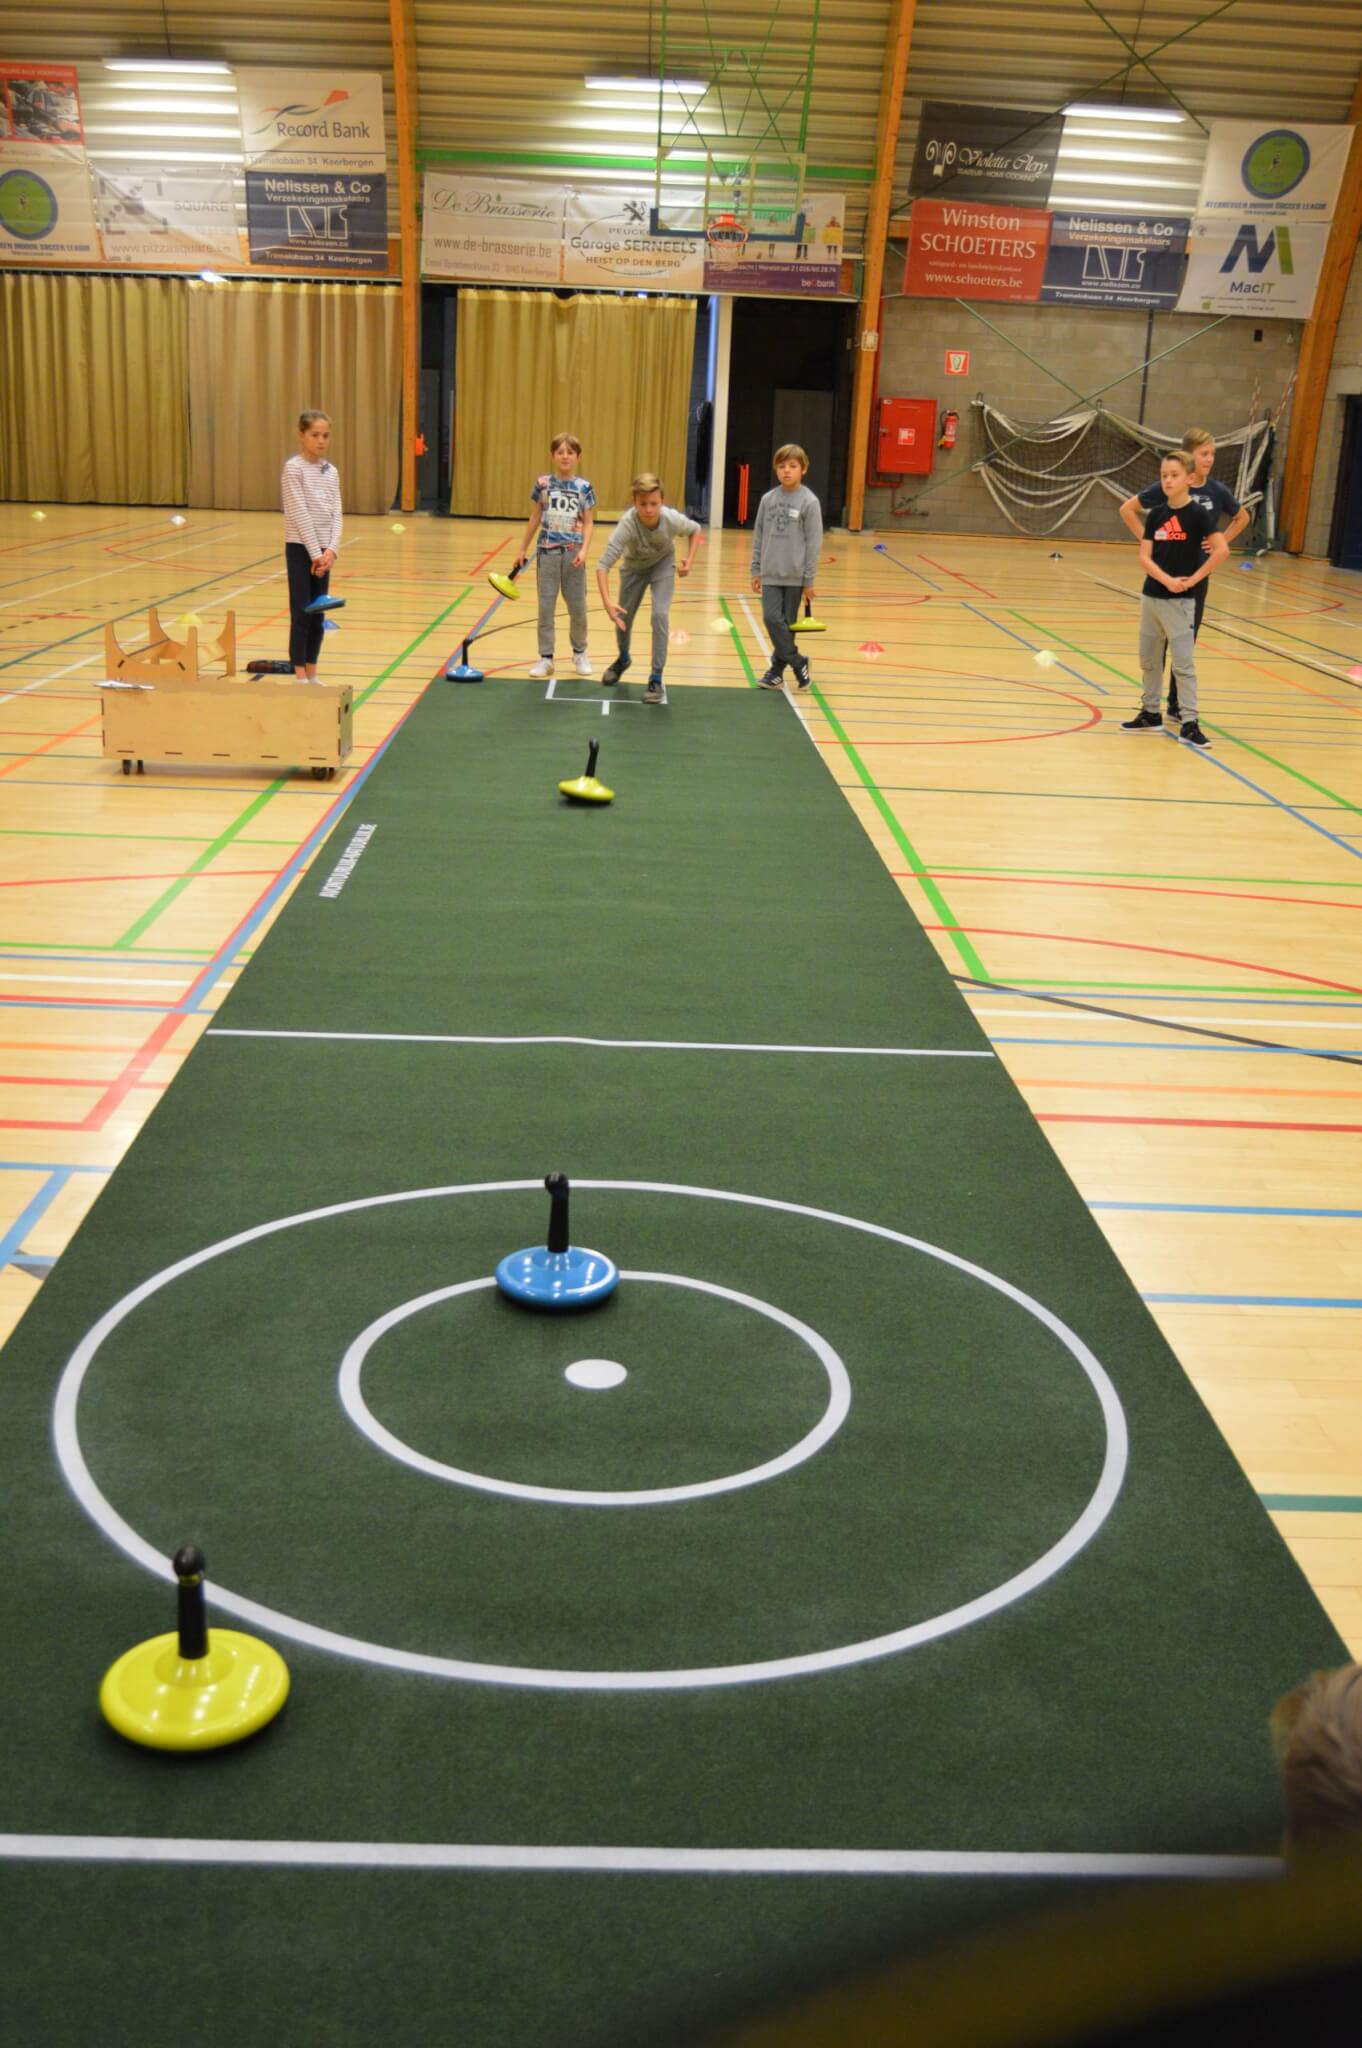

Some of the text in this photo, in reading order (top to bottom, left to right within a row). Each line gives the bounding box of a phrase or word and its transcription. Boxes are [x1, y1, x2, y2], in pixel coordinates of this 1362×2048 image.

[277, 120, 370, 138] Record Bank
[959, 147, 1011, 168] Violetta
[264, 178, 372, 194] Nelissen & Co
[174, 200, 229, 212] SQUARE
[432, 187, 555, 217] De Brasserie
[942, 207, 1020, 231] Winston
[1068, 216, 1174, 236] Nelissen & Co
[608, 227, 651, 236] PEUGE
[434, 234, 552, 258] www.de-brasserie.be
[570, 236, 697, 254] Garage SERNEELS
[920, 232, 1036, 259] SCHOETERS
[585, 256, 613, 265] HEIST
[632, 258, 652, 266] DEN
[655, 259, 681, 268] BERG
[925, 271, 1023, 288] www.schoeters.be
[1229, 281, 1275, 294] MacIT
